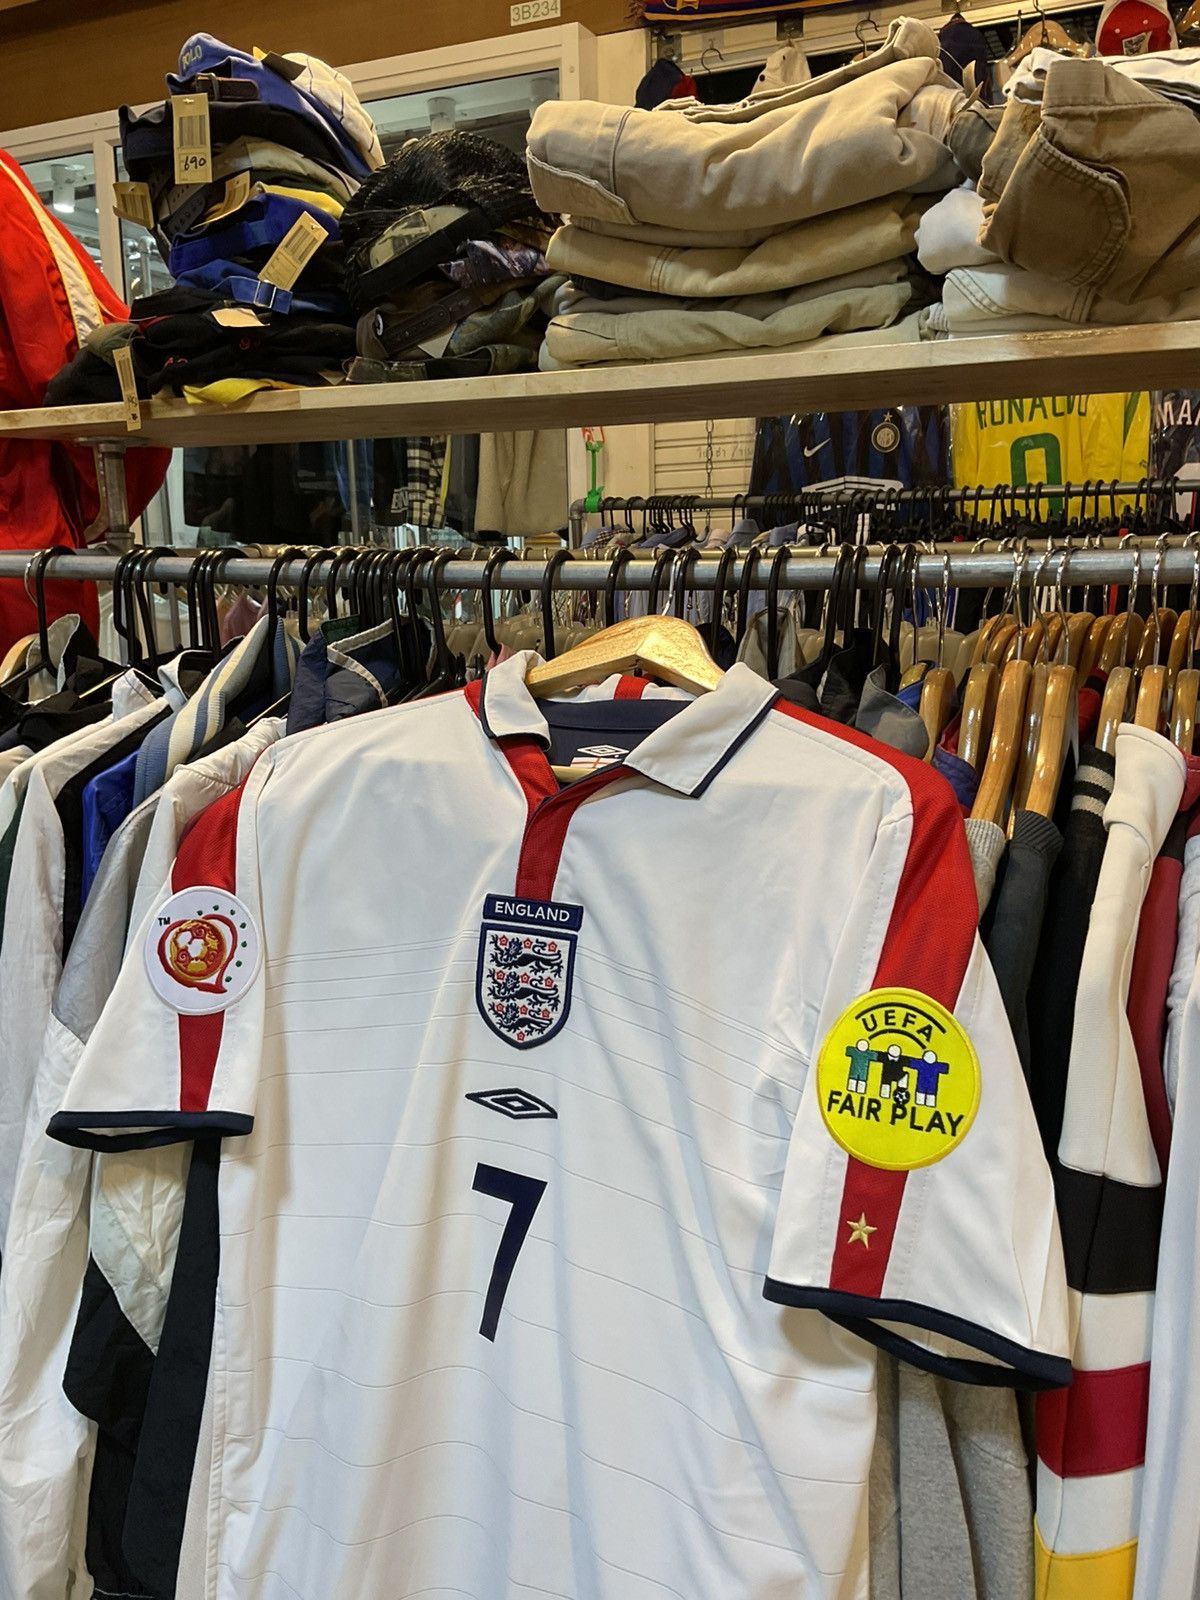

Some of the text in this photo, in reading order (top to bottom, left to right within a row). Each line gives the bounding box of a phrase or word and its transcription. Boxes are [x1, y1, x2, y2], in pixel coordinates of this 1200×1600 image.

[512, 0, 559, 22] 3B234
[183, 155, 207, 171] 690
[1153, 399, 1200, 430] MA
[157, 916, 171, 926] TM
[494, 900, 570, 922] ENGLAND
[861, 1009, 934, 1043] UEFA
[827, 1090, 964, 1137] FAIR PLAY
[472, 1162, 548, 1343] 7
